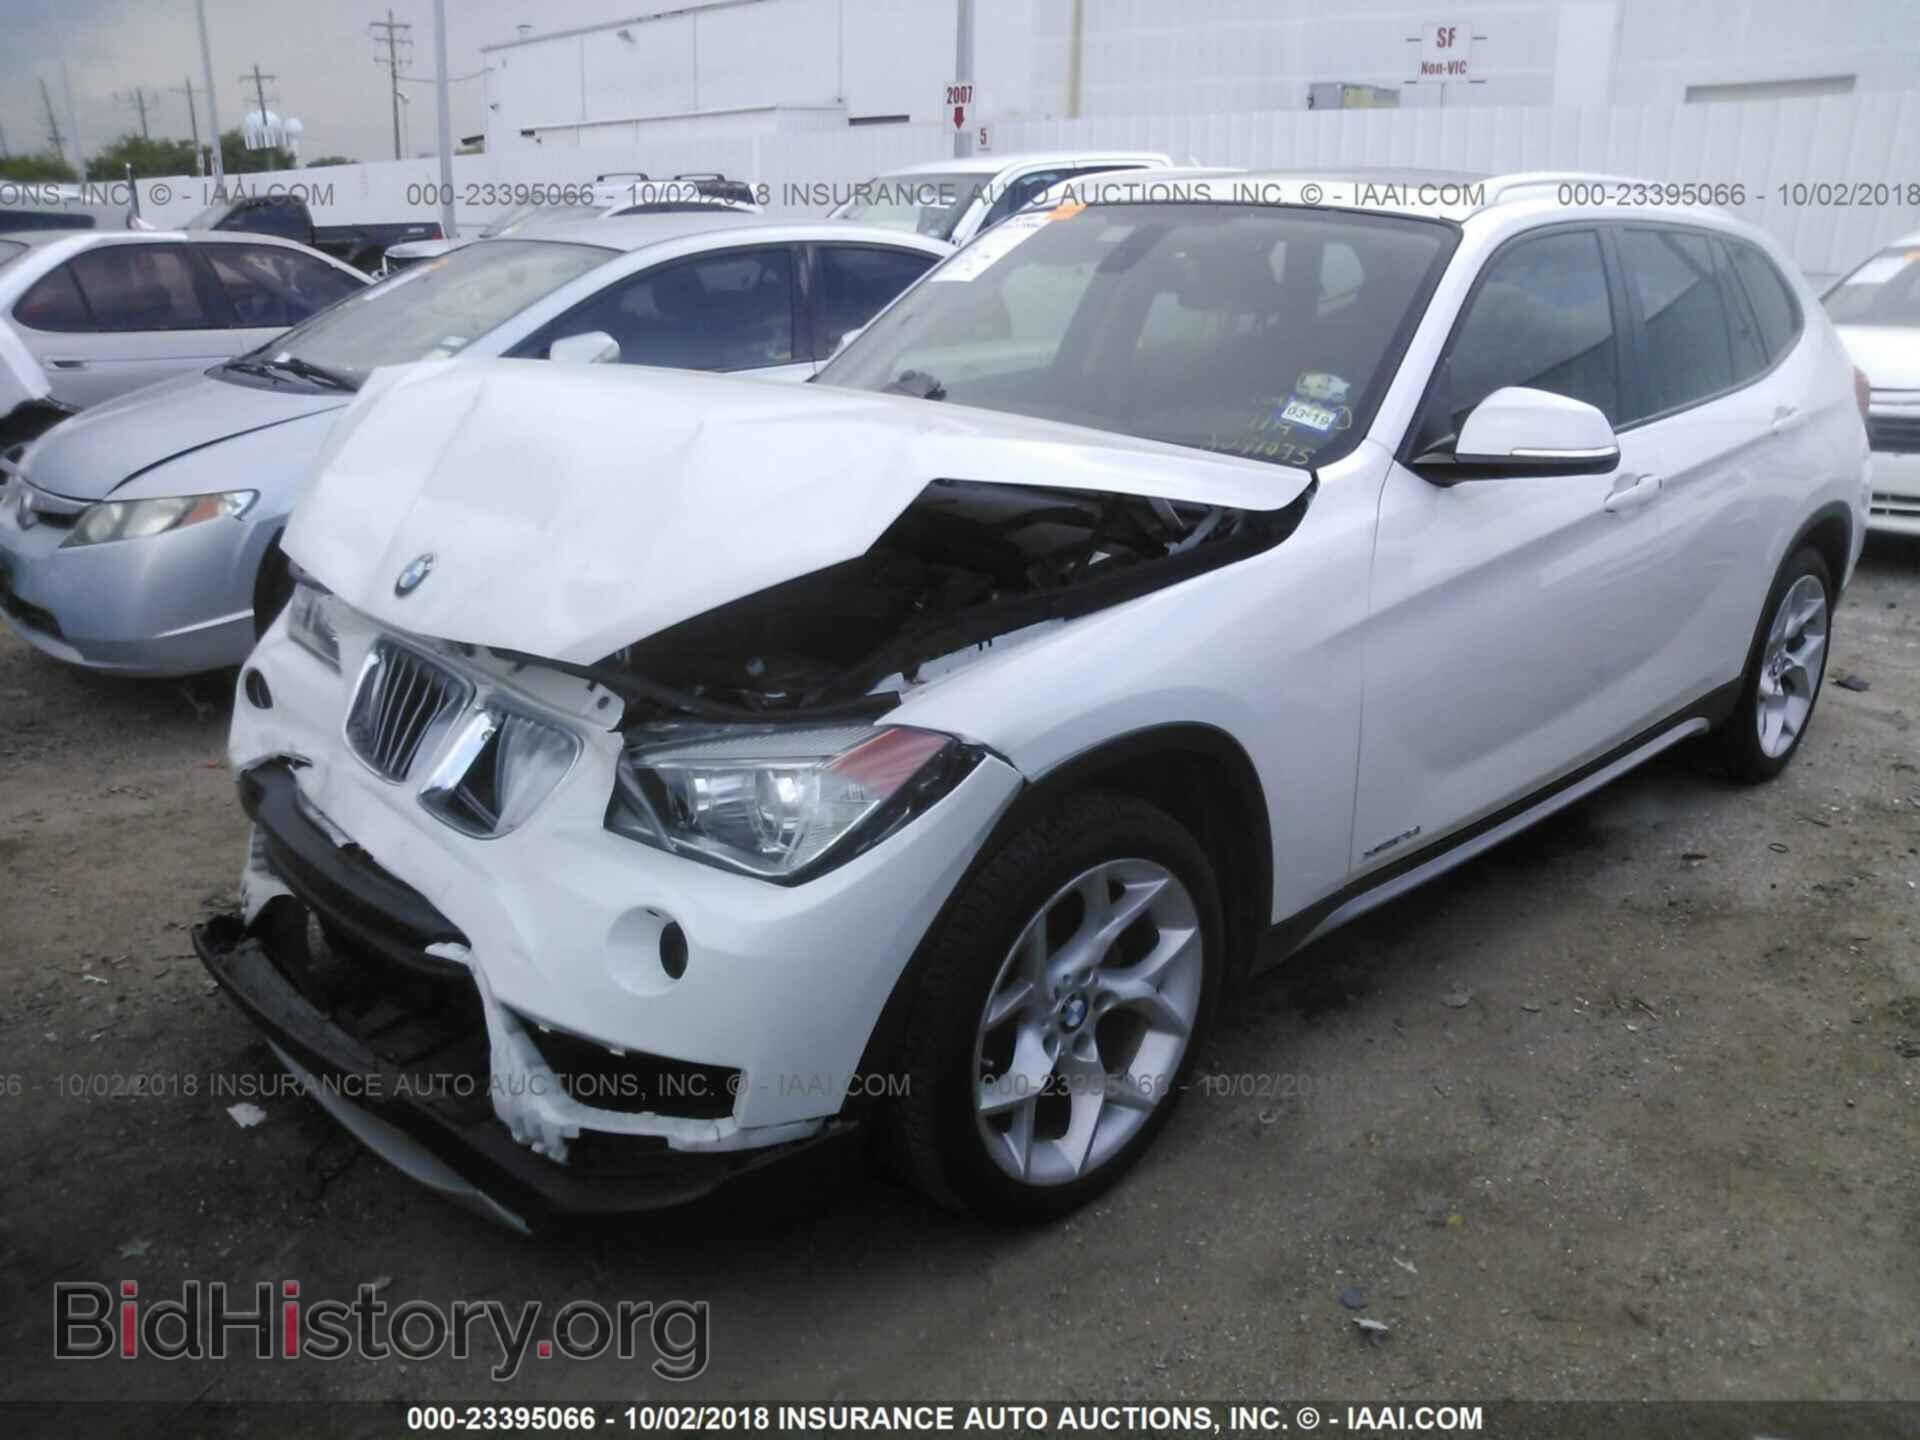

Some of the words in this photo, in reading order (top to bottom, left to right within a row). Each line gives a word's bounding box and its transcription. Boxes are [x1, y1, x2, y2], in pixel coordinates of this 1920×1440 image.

[1436, 27, 1456, 49] SF
[1421, 60, 1467, 76] Non-VIC
[946, 85, 973, 105] 2007
[980, 127, 987, 146] 5
